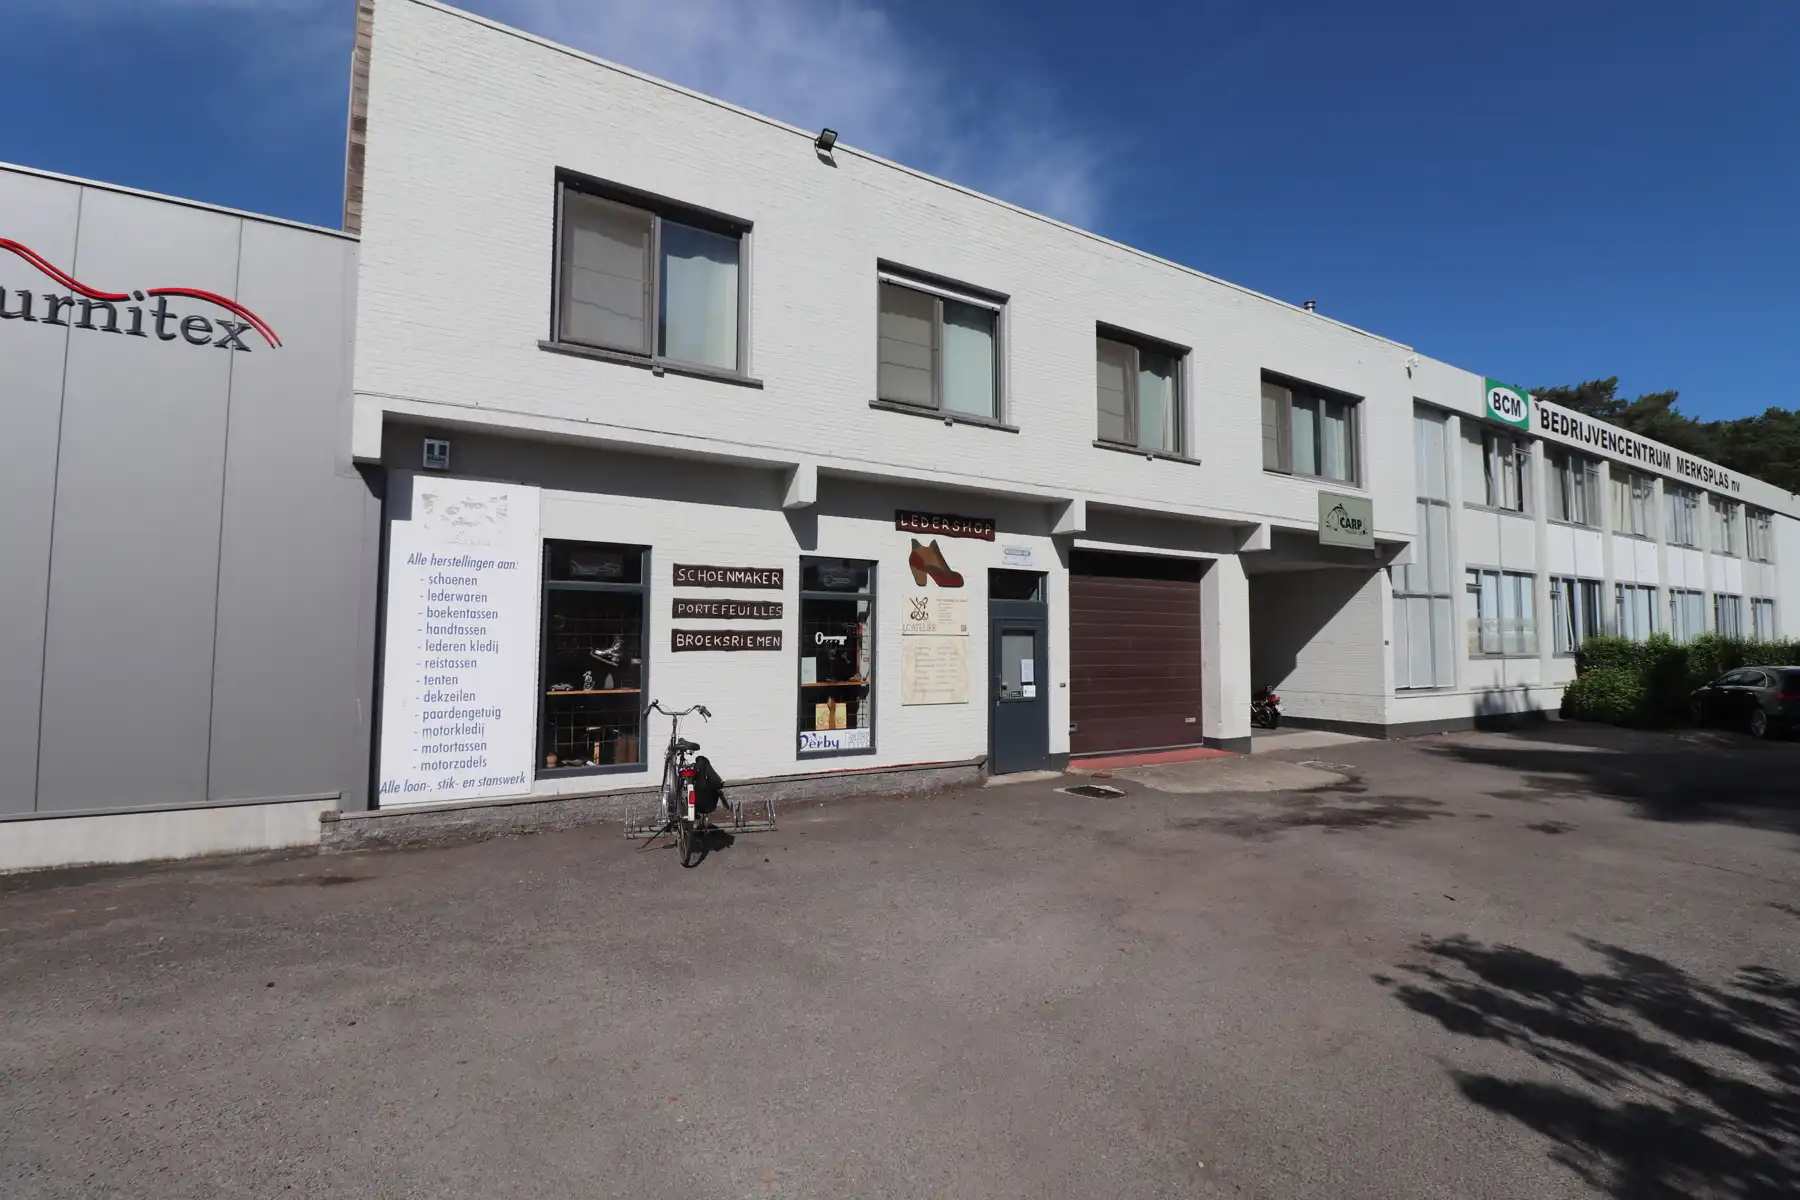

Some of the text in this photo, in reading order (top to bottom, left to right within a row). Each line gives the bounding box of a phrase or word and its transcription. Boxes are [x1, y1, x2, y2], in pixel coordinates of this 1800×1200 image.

[1493, 391, 1521, 417] BCM
[1541, 407, 1671, 470] BEDRIJVENCENTRUM
[1676, 456, 1729, 489] MERKSPLAS
[901, 513, 991, 535] LEDERSHOP
[1340, 516, 1362, 530] CARP
[407, 553, 427, 566] Alle
[430, 553, 494, 571] herstellingen
[428, 572, 478, 586] schoenen
[677, 568, 781, 585] SCHOENMAKER
[427, 589, 488, 603] lederwaren
[426, 606, 498, 619] boekentassen
[426, 622, 486, 636] handtassen
[425, 639, 499, 654] lederen kledij
[424, 657, 477, 669] reistassen
[424, 674, 458, 685] tenten
[423, 689, 476, 703] dekzeilen
[422, 706, 501, 722] paardengetuig
[422, 723, 485, 738] motorkledij
[421, 740, 487, 754] motortassen
[800, 734, 839, 750] Derby
[420, 756, 487, 771] motorzadels
[380, 780, 400, 794] Alle
[462, 779, 475, 788] en
[477, 771, 526, 787] stanswerk
